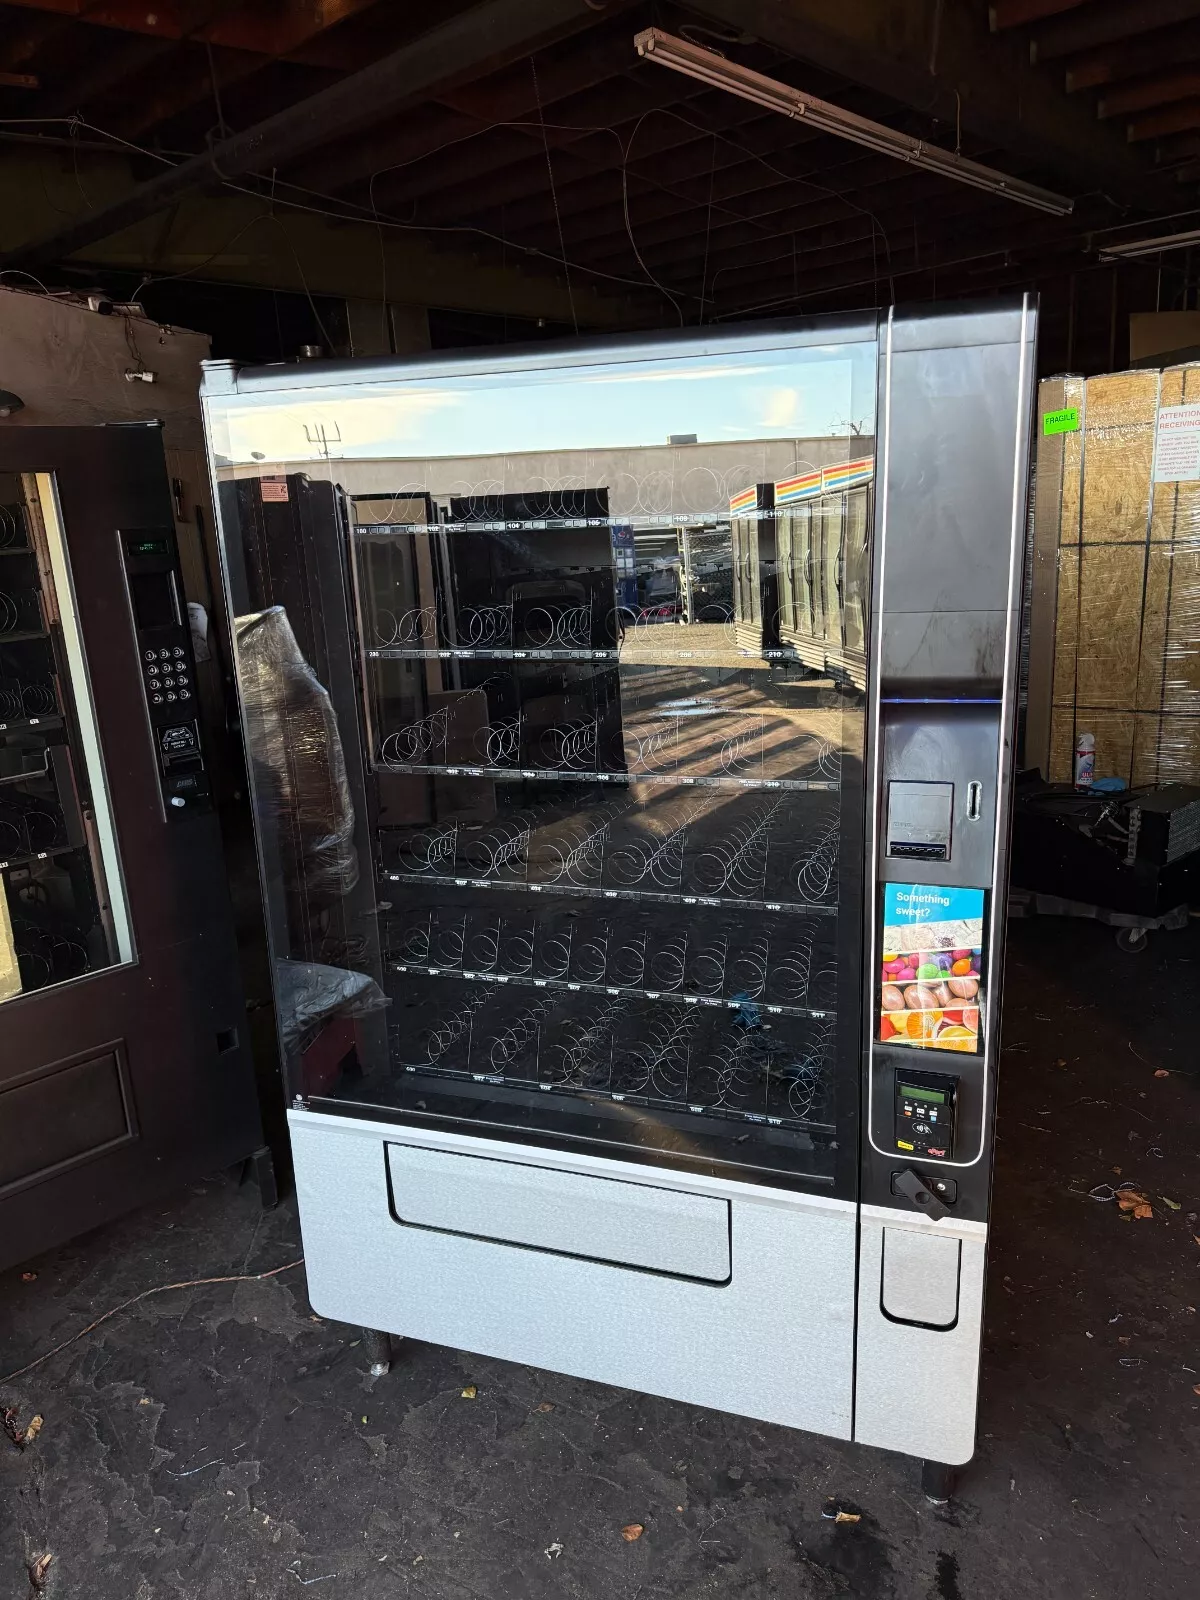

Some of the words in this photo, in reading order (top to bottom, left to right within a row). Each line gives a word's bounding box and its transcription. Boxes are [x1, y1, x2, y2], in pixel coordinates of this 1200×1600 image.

[1046, 412, 1075, 424] FRAGILE
[1160, 410, 1200, 420] ATTENTION
[1160, 420, 1200, 430] RECEIVING
[896, 892, 950, 906] Something
[896, 906, 930, 916] sweet?
